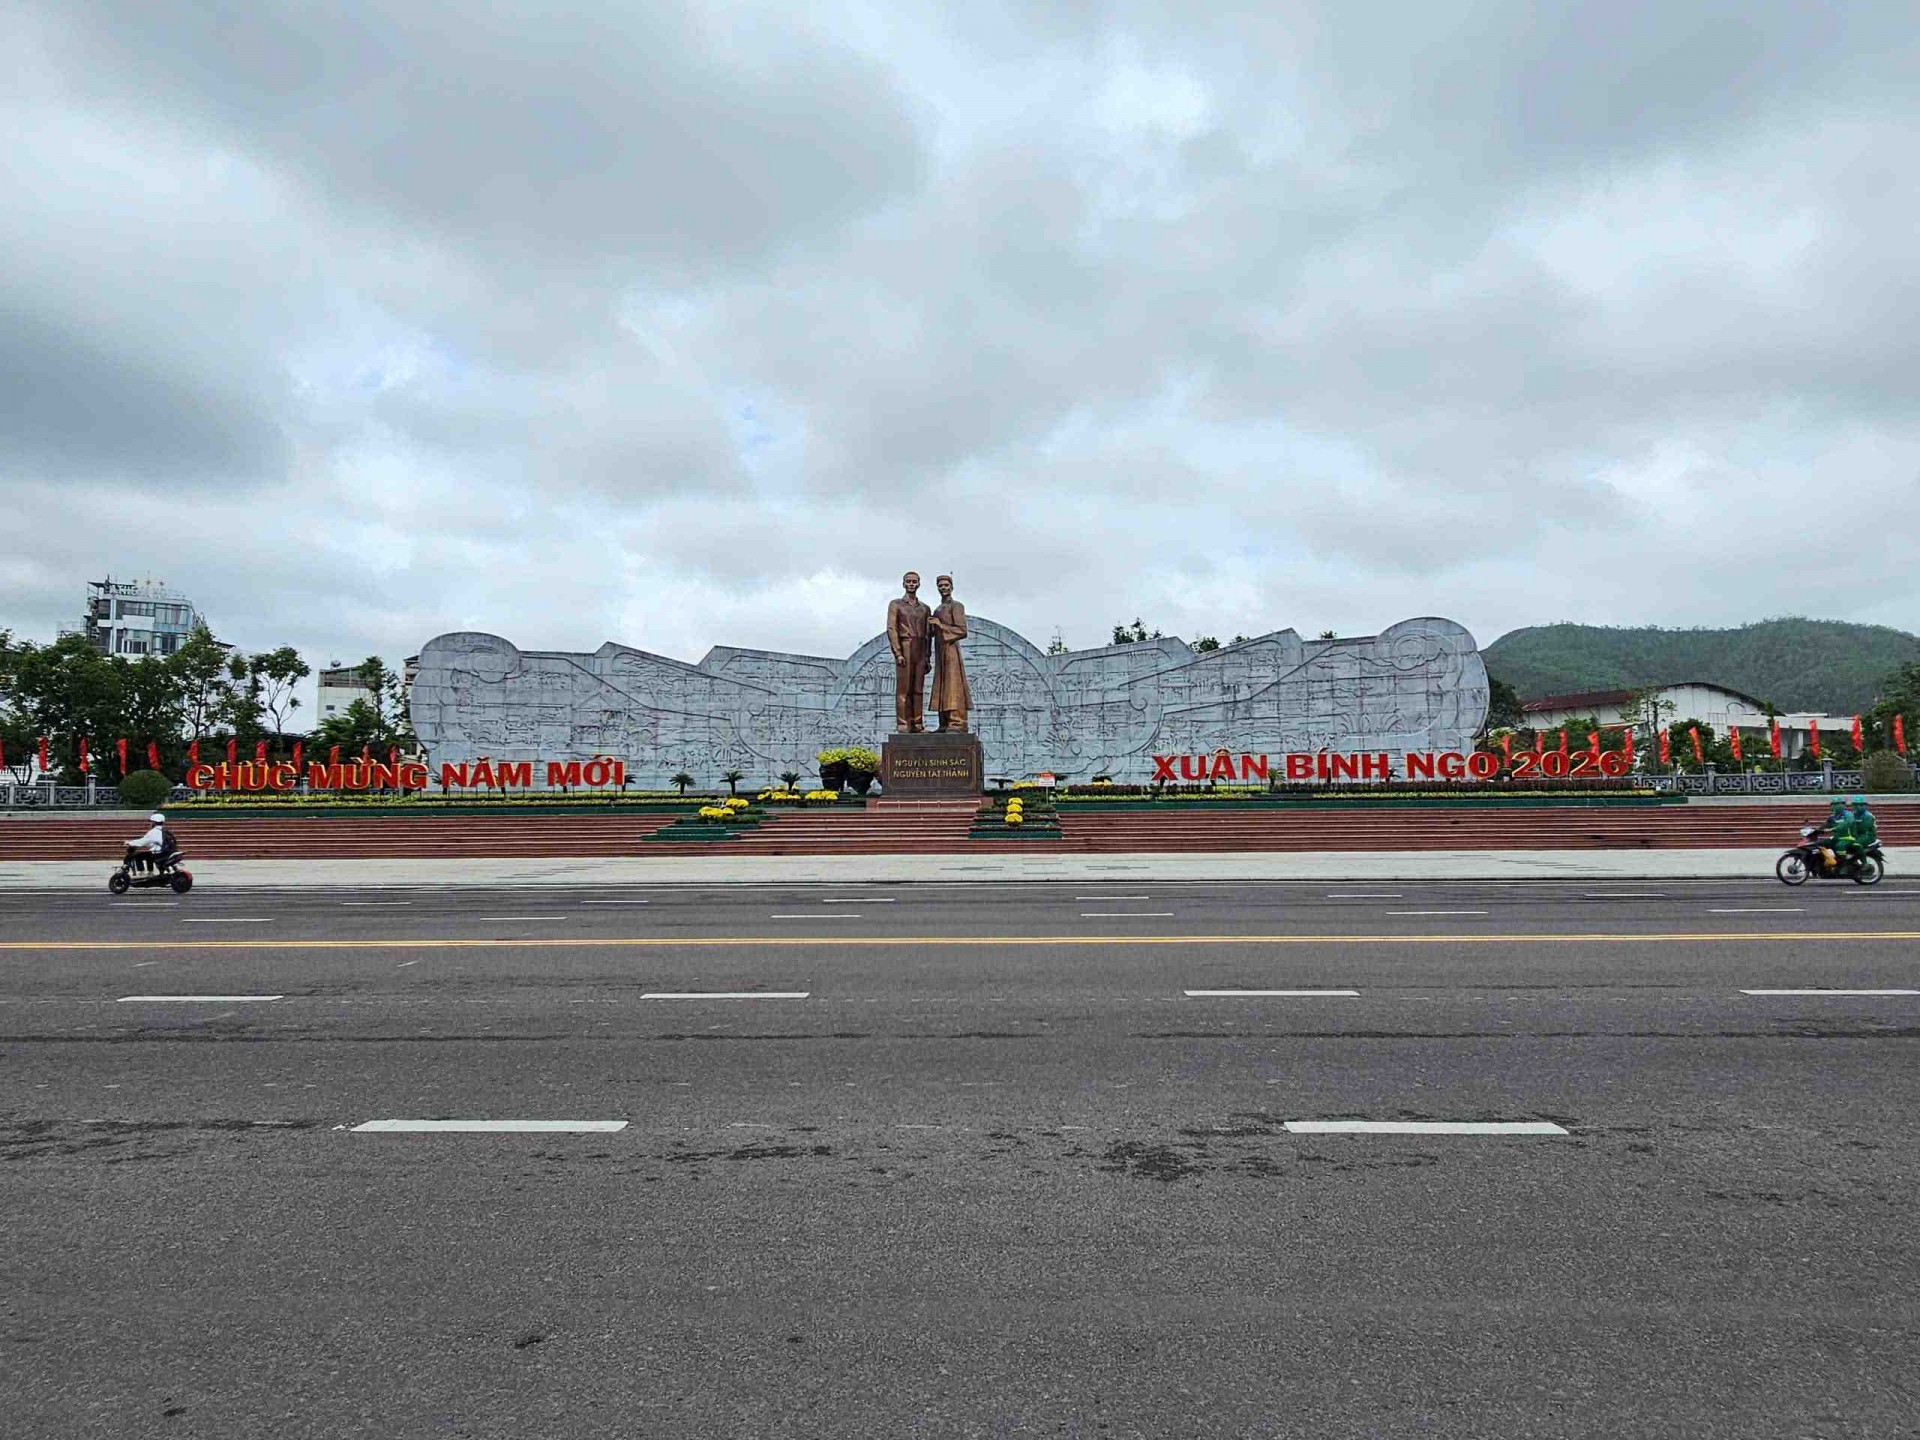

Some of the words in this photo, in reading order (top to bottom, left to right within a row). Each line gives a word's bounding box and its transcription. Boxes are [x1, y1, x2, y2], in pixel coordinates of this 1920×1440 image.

[186, 757, 297, 790] CHÚC
[308, 757, 428, 790] MỪNG
[441, 756, 532, 787] NĂM
[547, 754, 624, 787] MỚI
[929, 759, 948, 767] SINH
[1152, 747, 1268, 780] XUÂN
[1286, 747, 1389, 779] BÍNH
[1511, 750, 1629, 778] 2026
